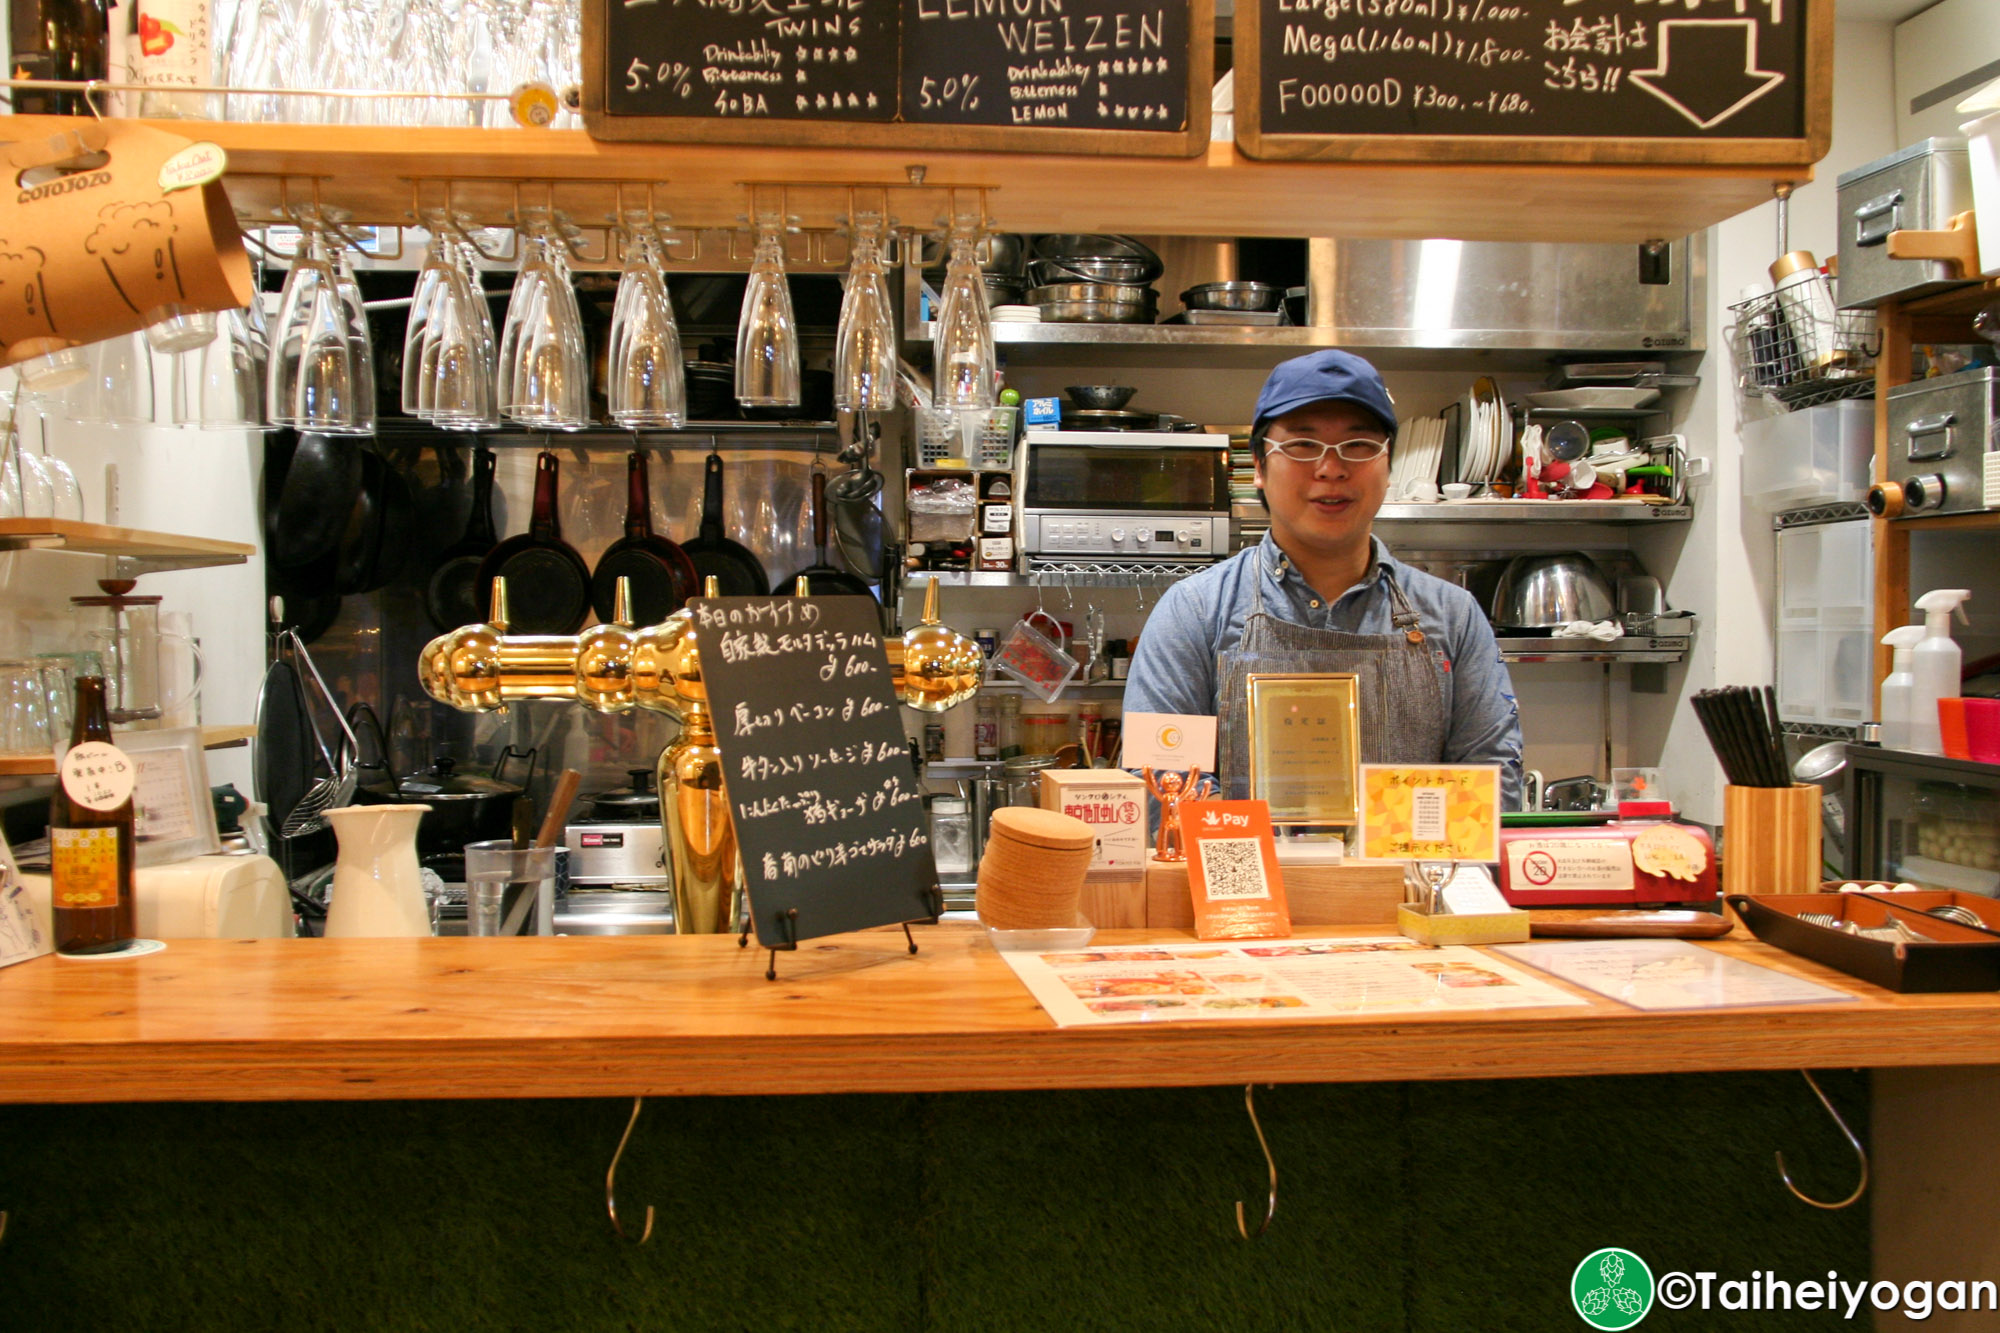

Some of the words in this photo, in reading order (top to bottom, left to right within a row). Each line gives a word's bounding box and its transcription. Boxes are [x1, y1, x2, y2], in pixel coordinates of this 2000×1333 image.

[765, 14, 861, 38] TWINS
[998, 9, 1163, 54] WEIZEN
[1543, 13, 1649, 54] お会計は
[625, 57, 692, 98] 5.0%
[920, 73, 980, 111] 5.0%
[1011, 102, 1069, 123] LEMON
[1389, 775, 1469, 785] ポイントカード
[1222, 812, 1249, 828] Pay
[1389, 842, 1467, 853] ご提示ください
